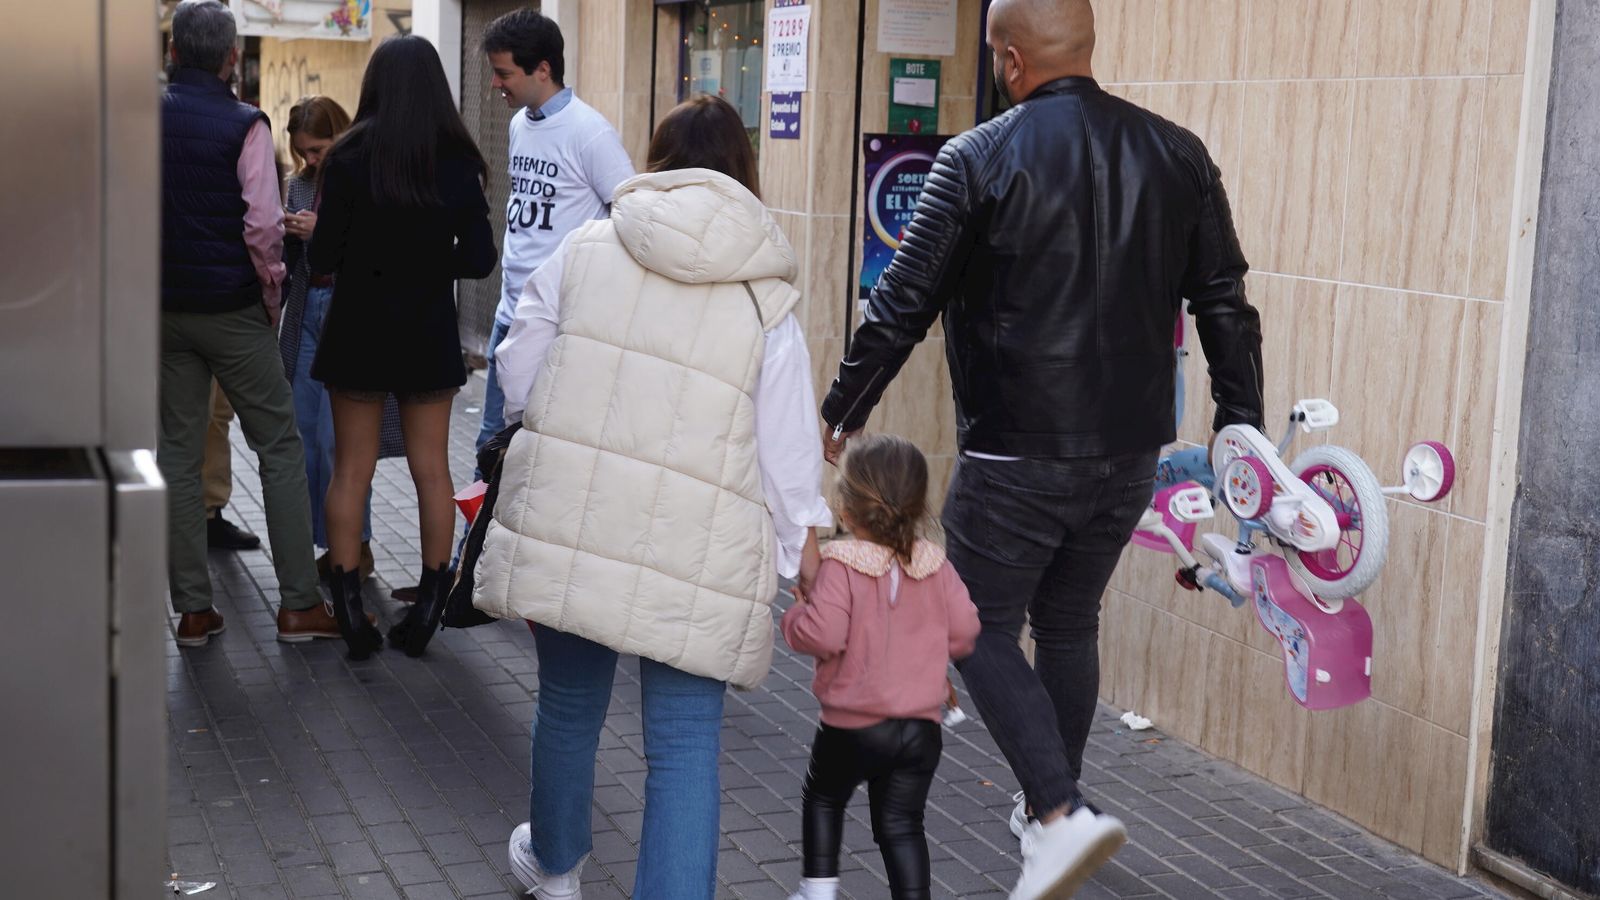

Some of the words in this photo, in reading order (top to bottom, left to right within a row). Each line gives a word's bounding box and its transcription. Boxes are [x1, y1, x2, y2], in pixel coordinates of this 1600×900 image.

[772, 18, 804, 37] 72289
[777, 42, 801, 57] PREMIO
[905, 63, 926, 76] BOTE
[885, 194, 903, 210] EL
[507, 198, 556, 234] QUÍ
